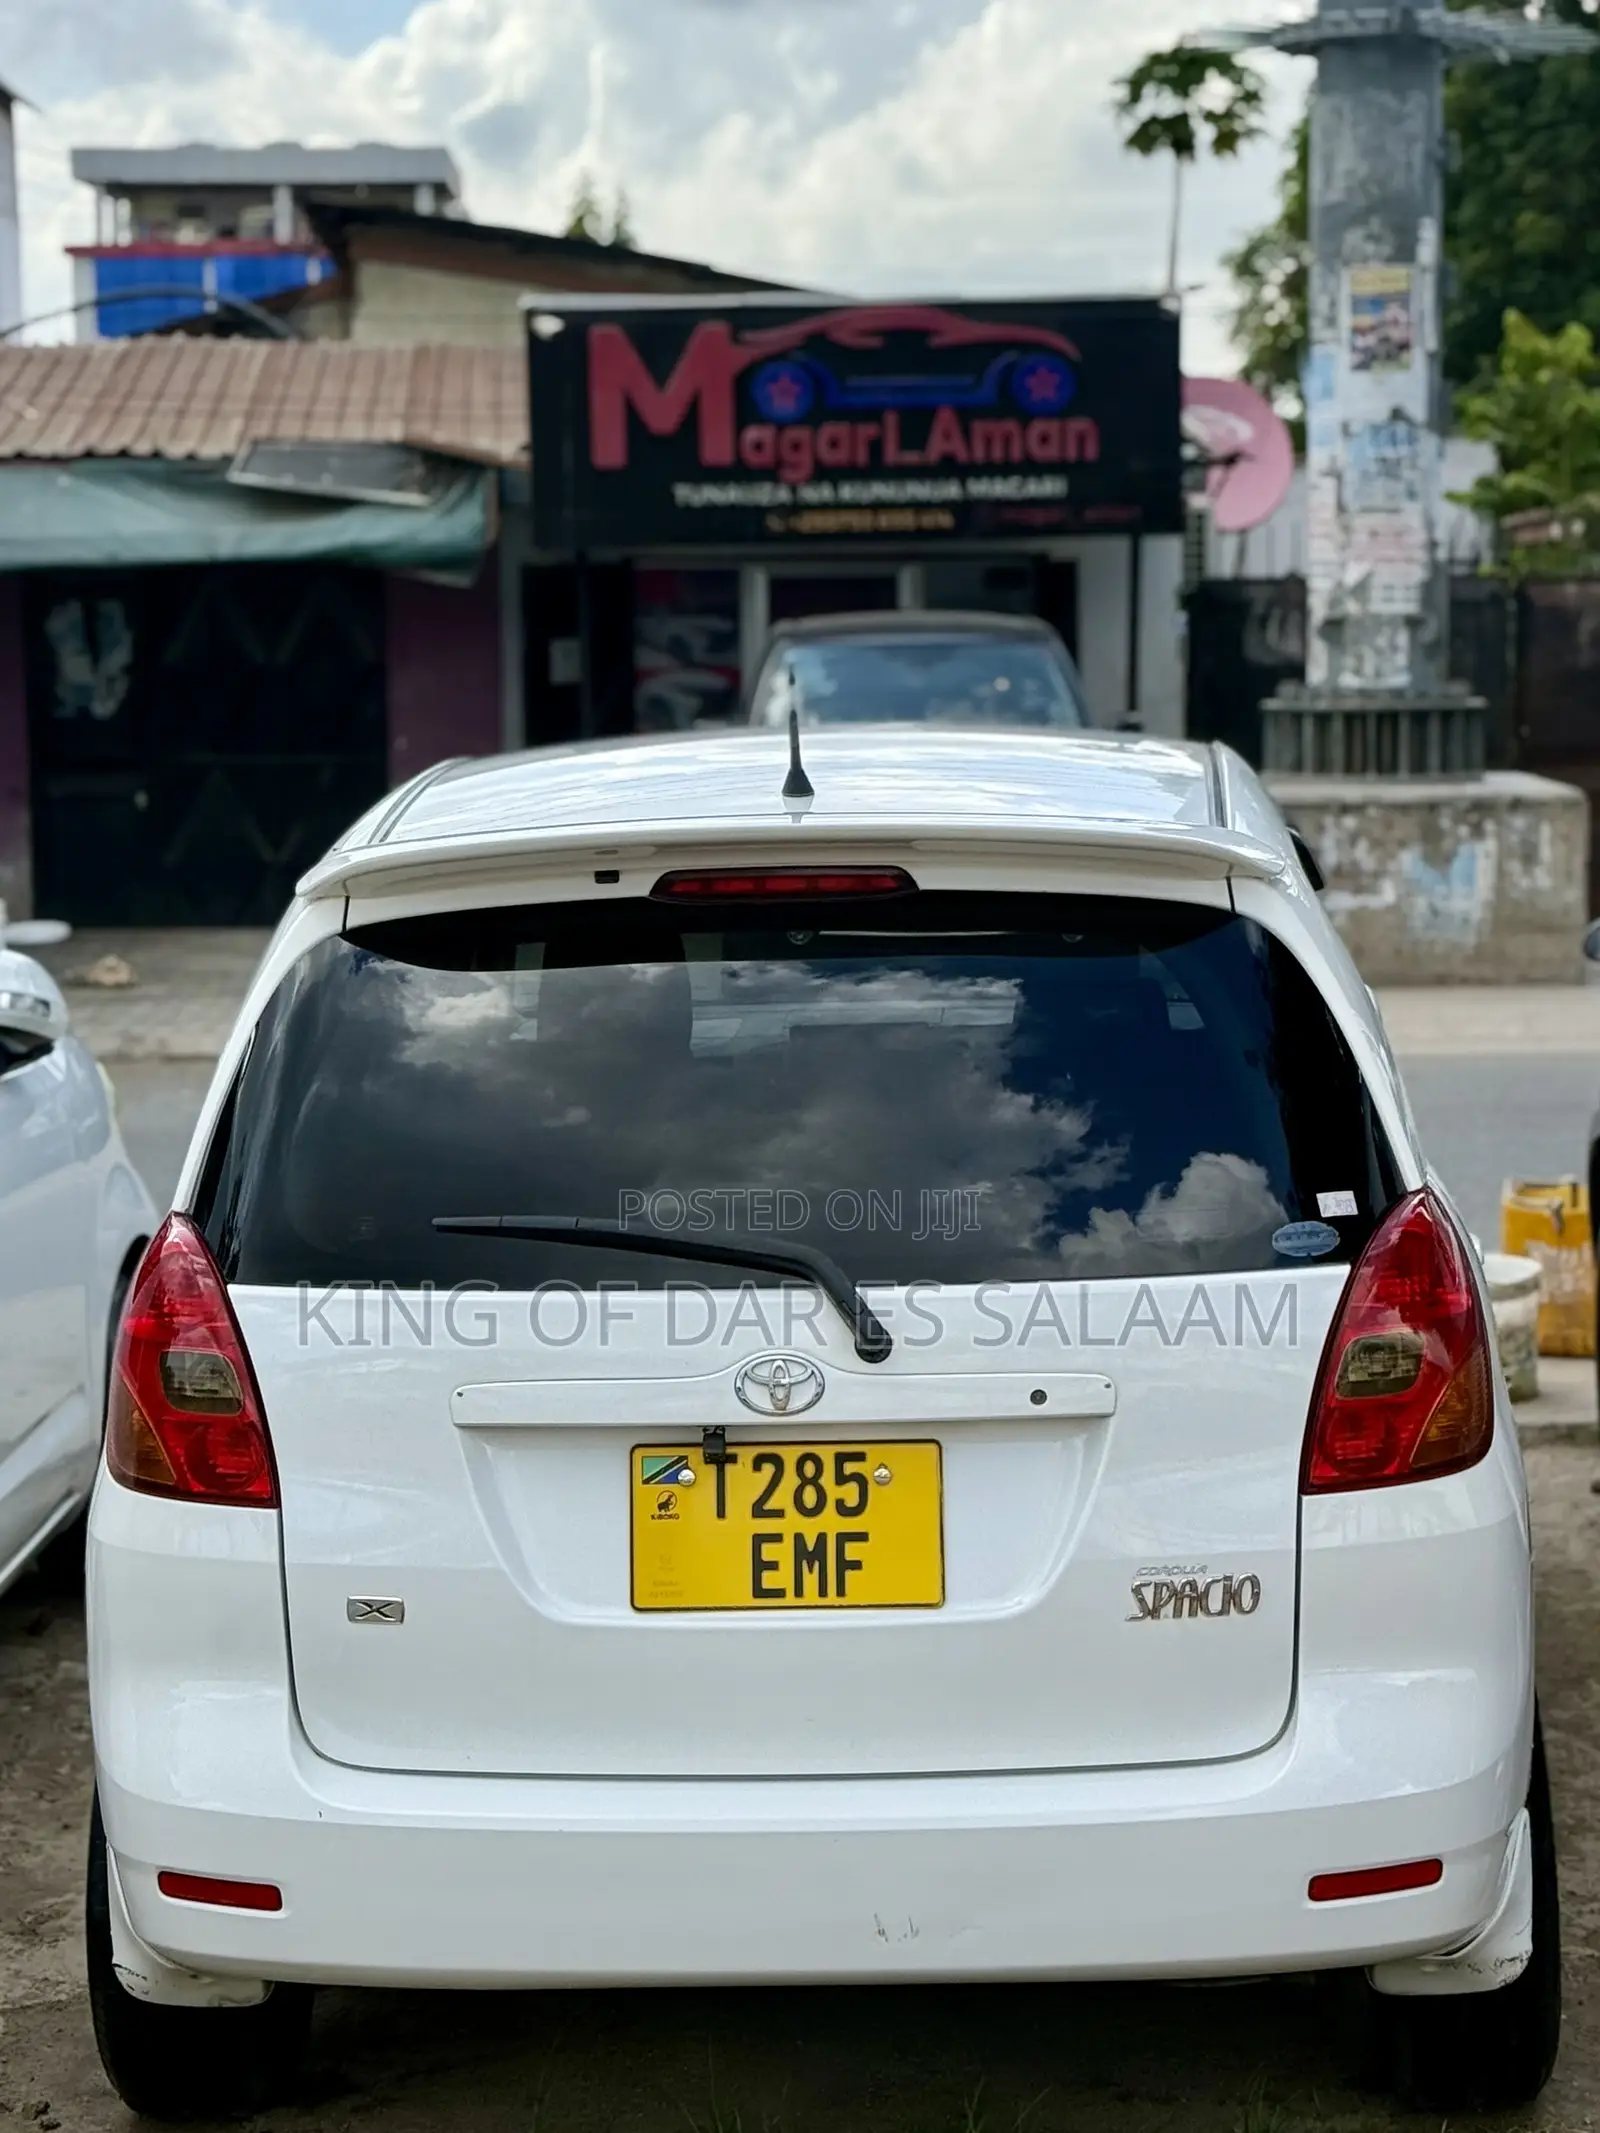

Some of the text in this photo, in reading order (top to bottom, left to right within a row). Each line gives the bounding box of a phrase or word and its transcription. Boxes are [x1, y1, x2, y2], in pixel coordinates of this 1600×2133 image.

[704, 1452, 869, 1519] T 285
[752, 1532, 869, 1598] EMF
[1136, 1564, 1208, 1576] COROLLA
[1125, 1573, 1262, 1622] SPACIO
